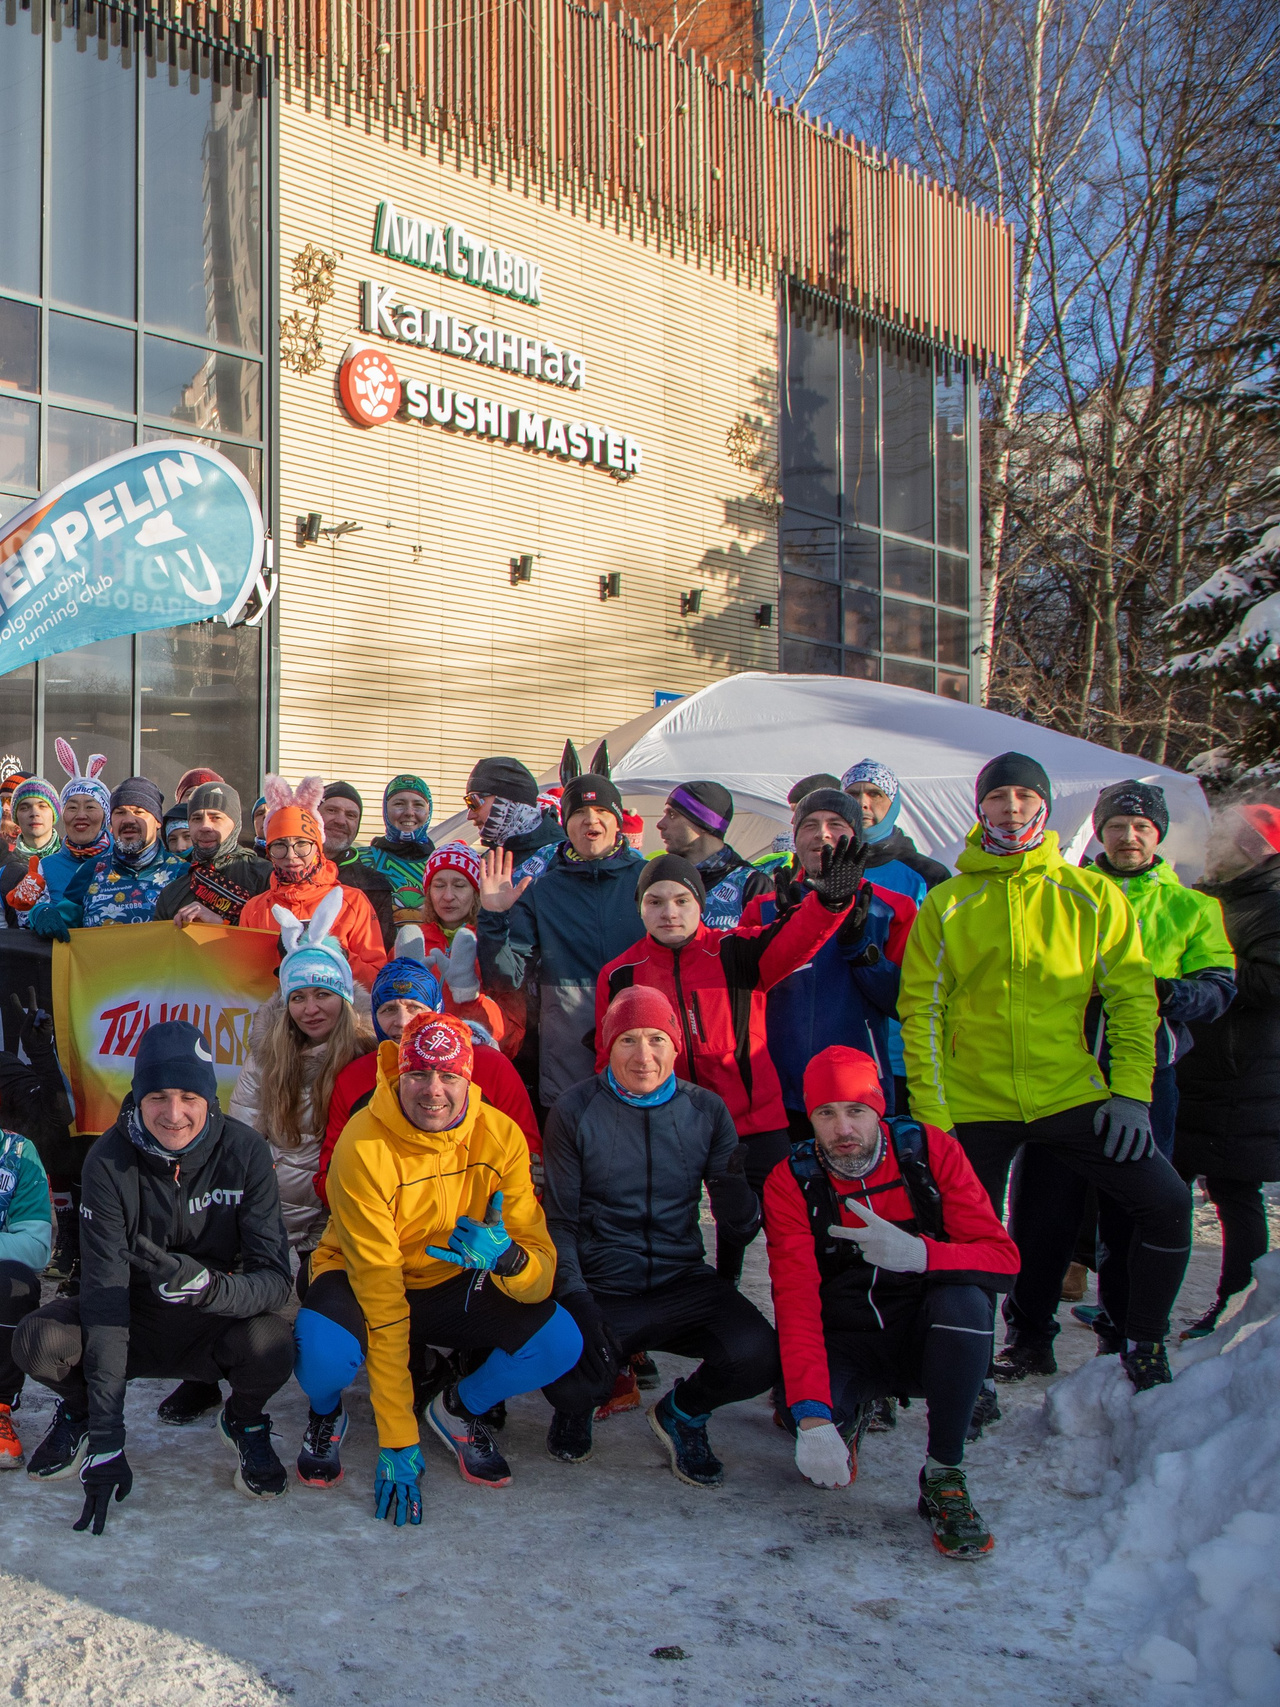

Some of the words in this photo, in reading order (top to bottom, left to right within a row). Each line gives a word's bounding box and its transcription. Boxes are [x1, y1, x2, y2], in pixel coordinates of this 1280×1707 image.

[360, 280, 586, 390] Кальянная
[404, 379, 511, 440] SUSHI
[517, 411, 643, 474] MASTER
[18, 599, 80, 651] running
[79, 574, 114, 605] club
